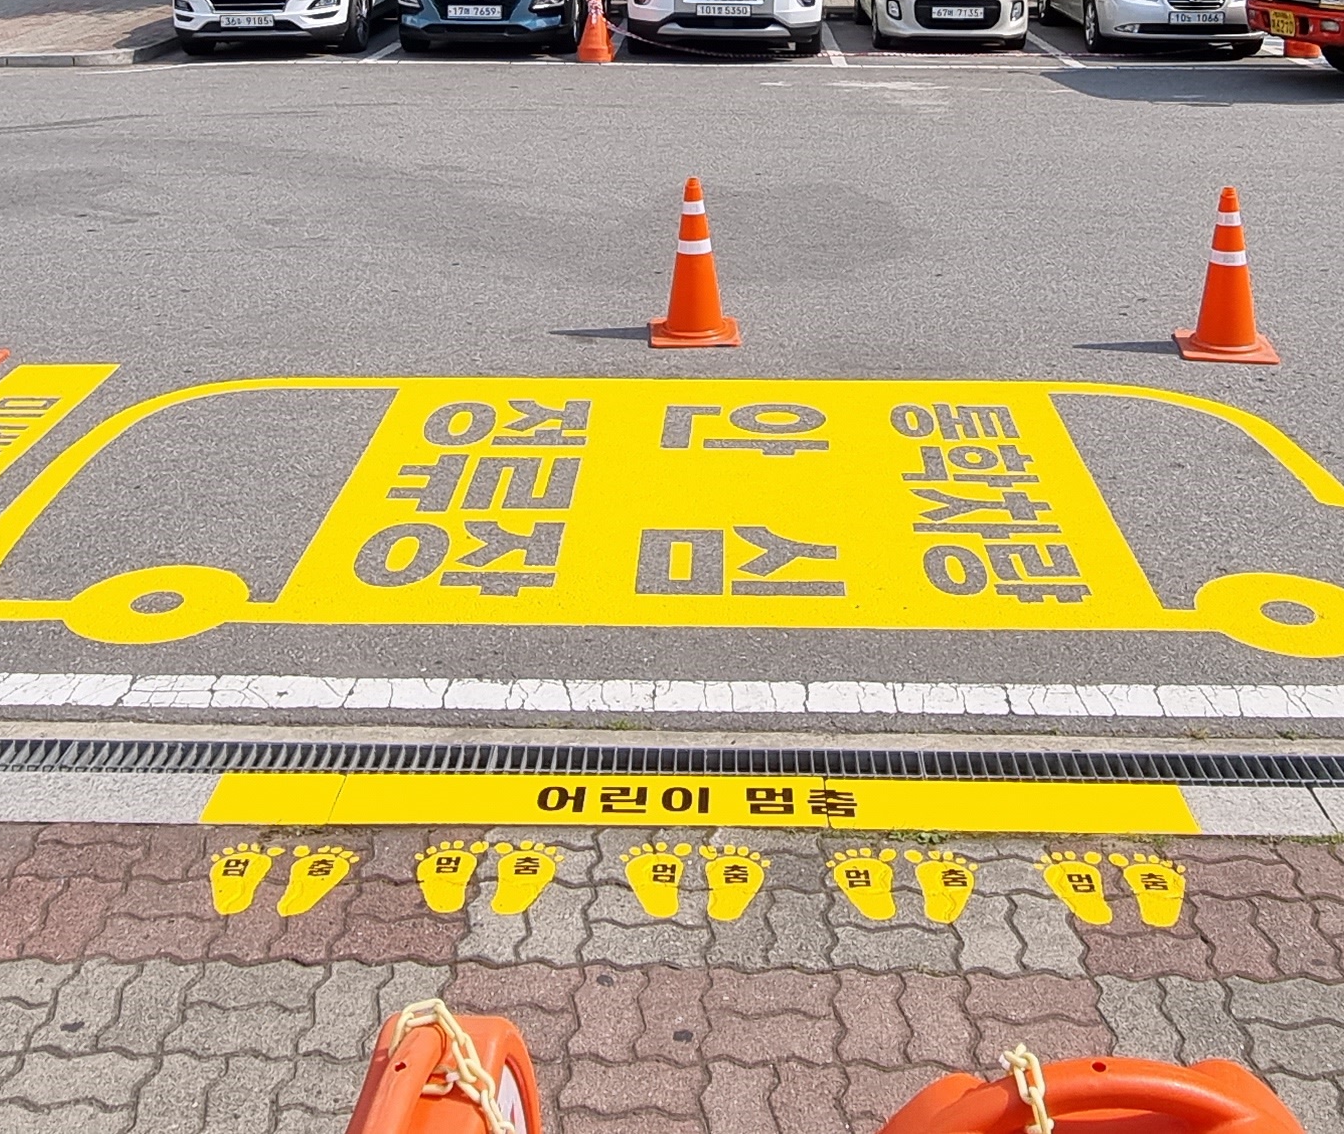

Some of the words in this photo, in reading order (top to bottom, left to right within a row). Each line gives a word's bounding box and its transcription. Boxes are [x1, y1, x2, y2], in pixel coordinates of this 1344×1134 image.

[352, 398, 592, 597] 정류장
[889, 401, 1092, 607] 통학차량
[536, 786, 711, 815] 어린이
[745, 787, 858, 818] 멈춤
[223, 857, 249, 878] 멈
[308, 857, 334, 877] 춤
[435, 853, 461, 874] 멈
[513, 854, 540, 876] 춤
[651, 861, 677, 884] 멈
[722, 863, 749, 885] 춤
[845, 868, 871, 889] 멈
[941, 865, 968, 888] 춤
[1068, 872, 1094, 893] 멈
[1141, 870, 1168, 891] 춤
